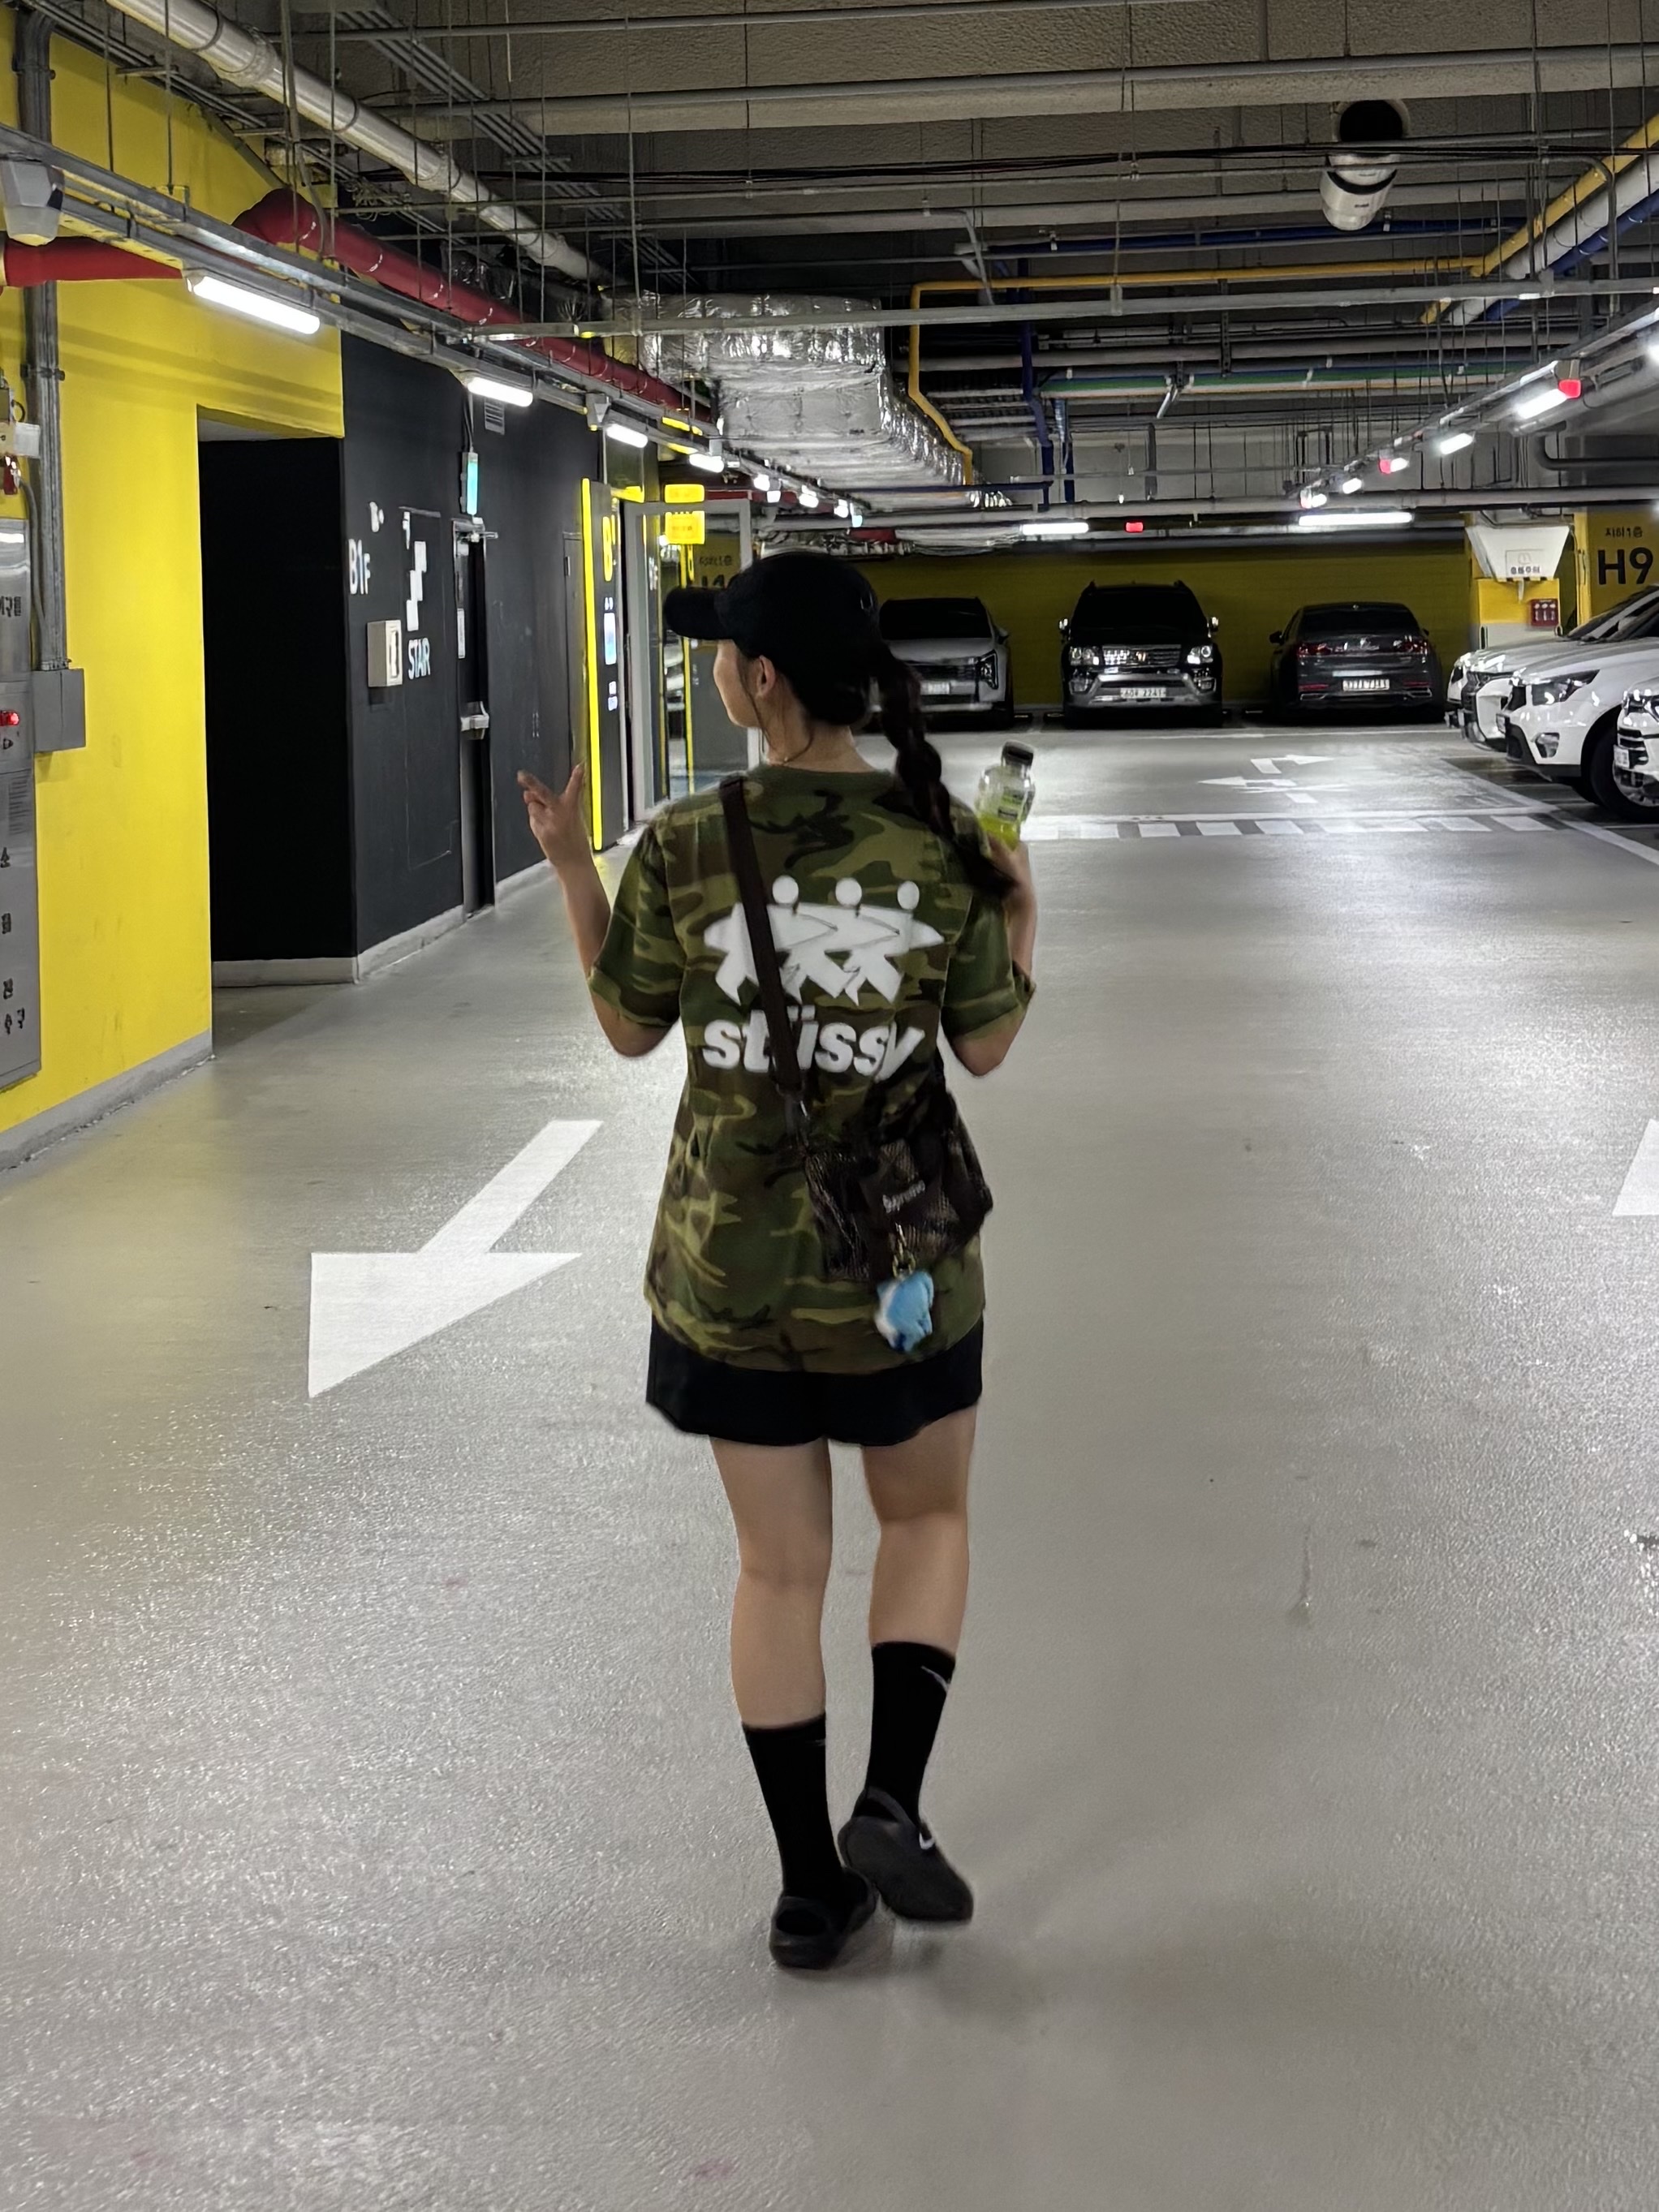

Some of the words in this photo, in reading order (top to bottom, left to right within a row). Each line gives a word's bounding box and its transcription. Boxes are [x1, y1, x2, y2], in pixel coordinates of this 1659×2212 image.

[1605, 526, 1644, 538] 지하1층
[348, 538, 371, 595] B1F
[1597, 546, 1654, 585] H9
